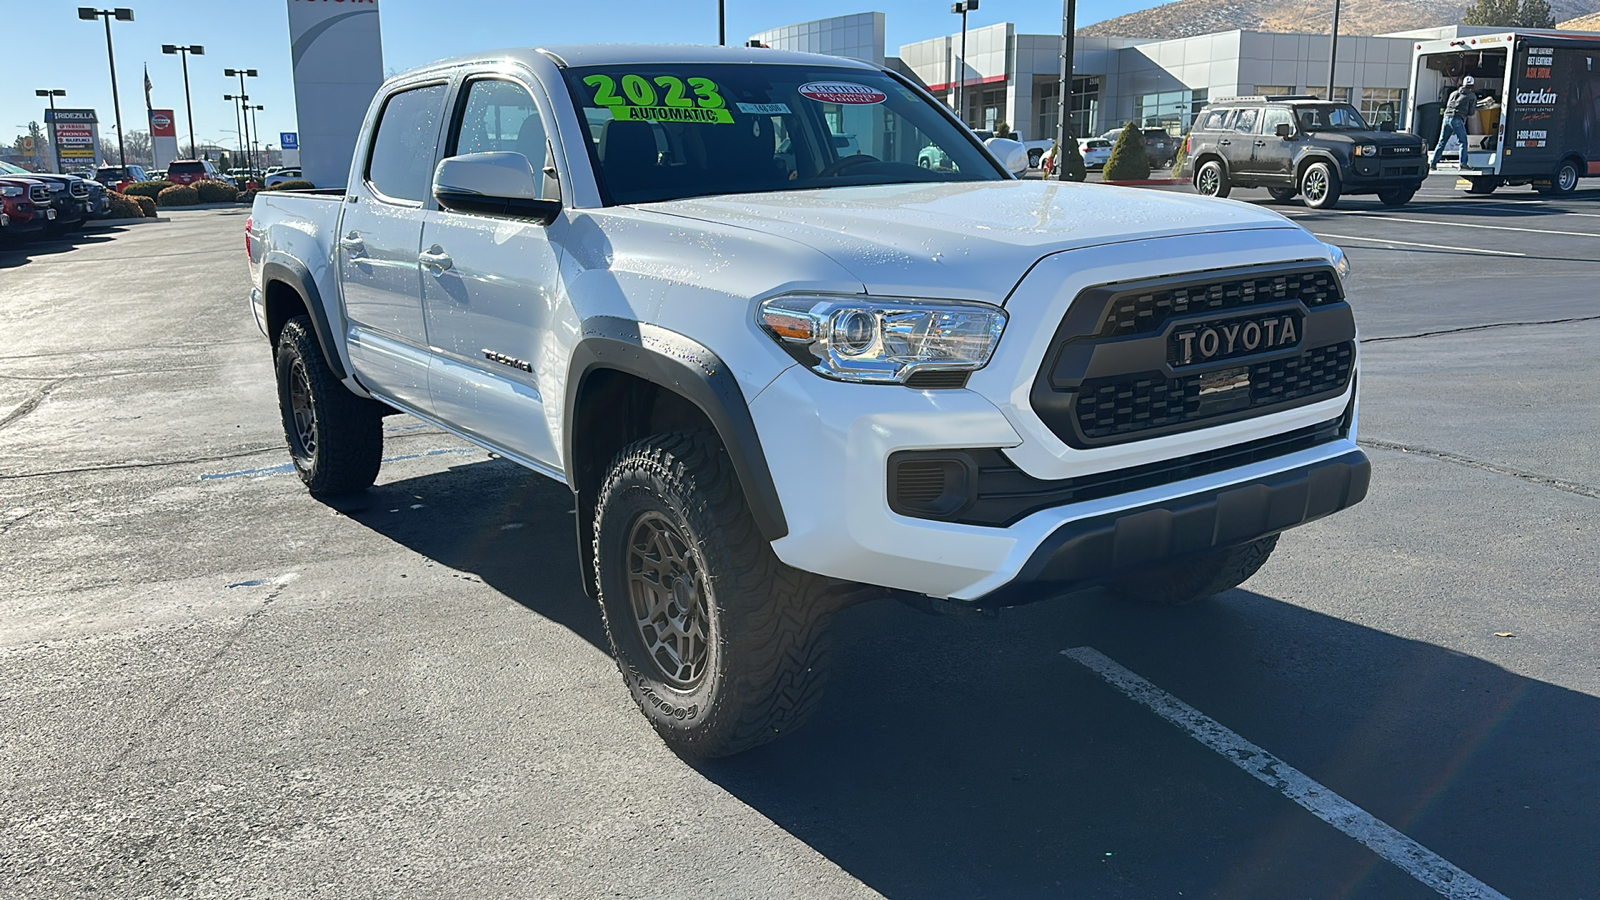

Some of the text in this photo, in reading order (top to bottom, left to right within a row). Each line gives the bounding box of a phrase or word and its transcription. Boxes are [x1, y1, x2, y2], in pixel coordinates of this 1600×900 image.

[1527, 56, 1535, 66] GET
[1525, 67, 1537, 78] ASK
[582, 74, 726, 109] 2023
[805, 85, 873, 93] CERTIFIED
[1516, 87, 1557, 104] katzkin
[628, 107, 719, 122] AUTOMATIC
[1177, 316, 1297, 363] TOYOTA
[637, 678, 698, 721] GOODY
